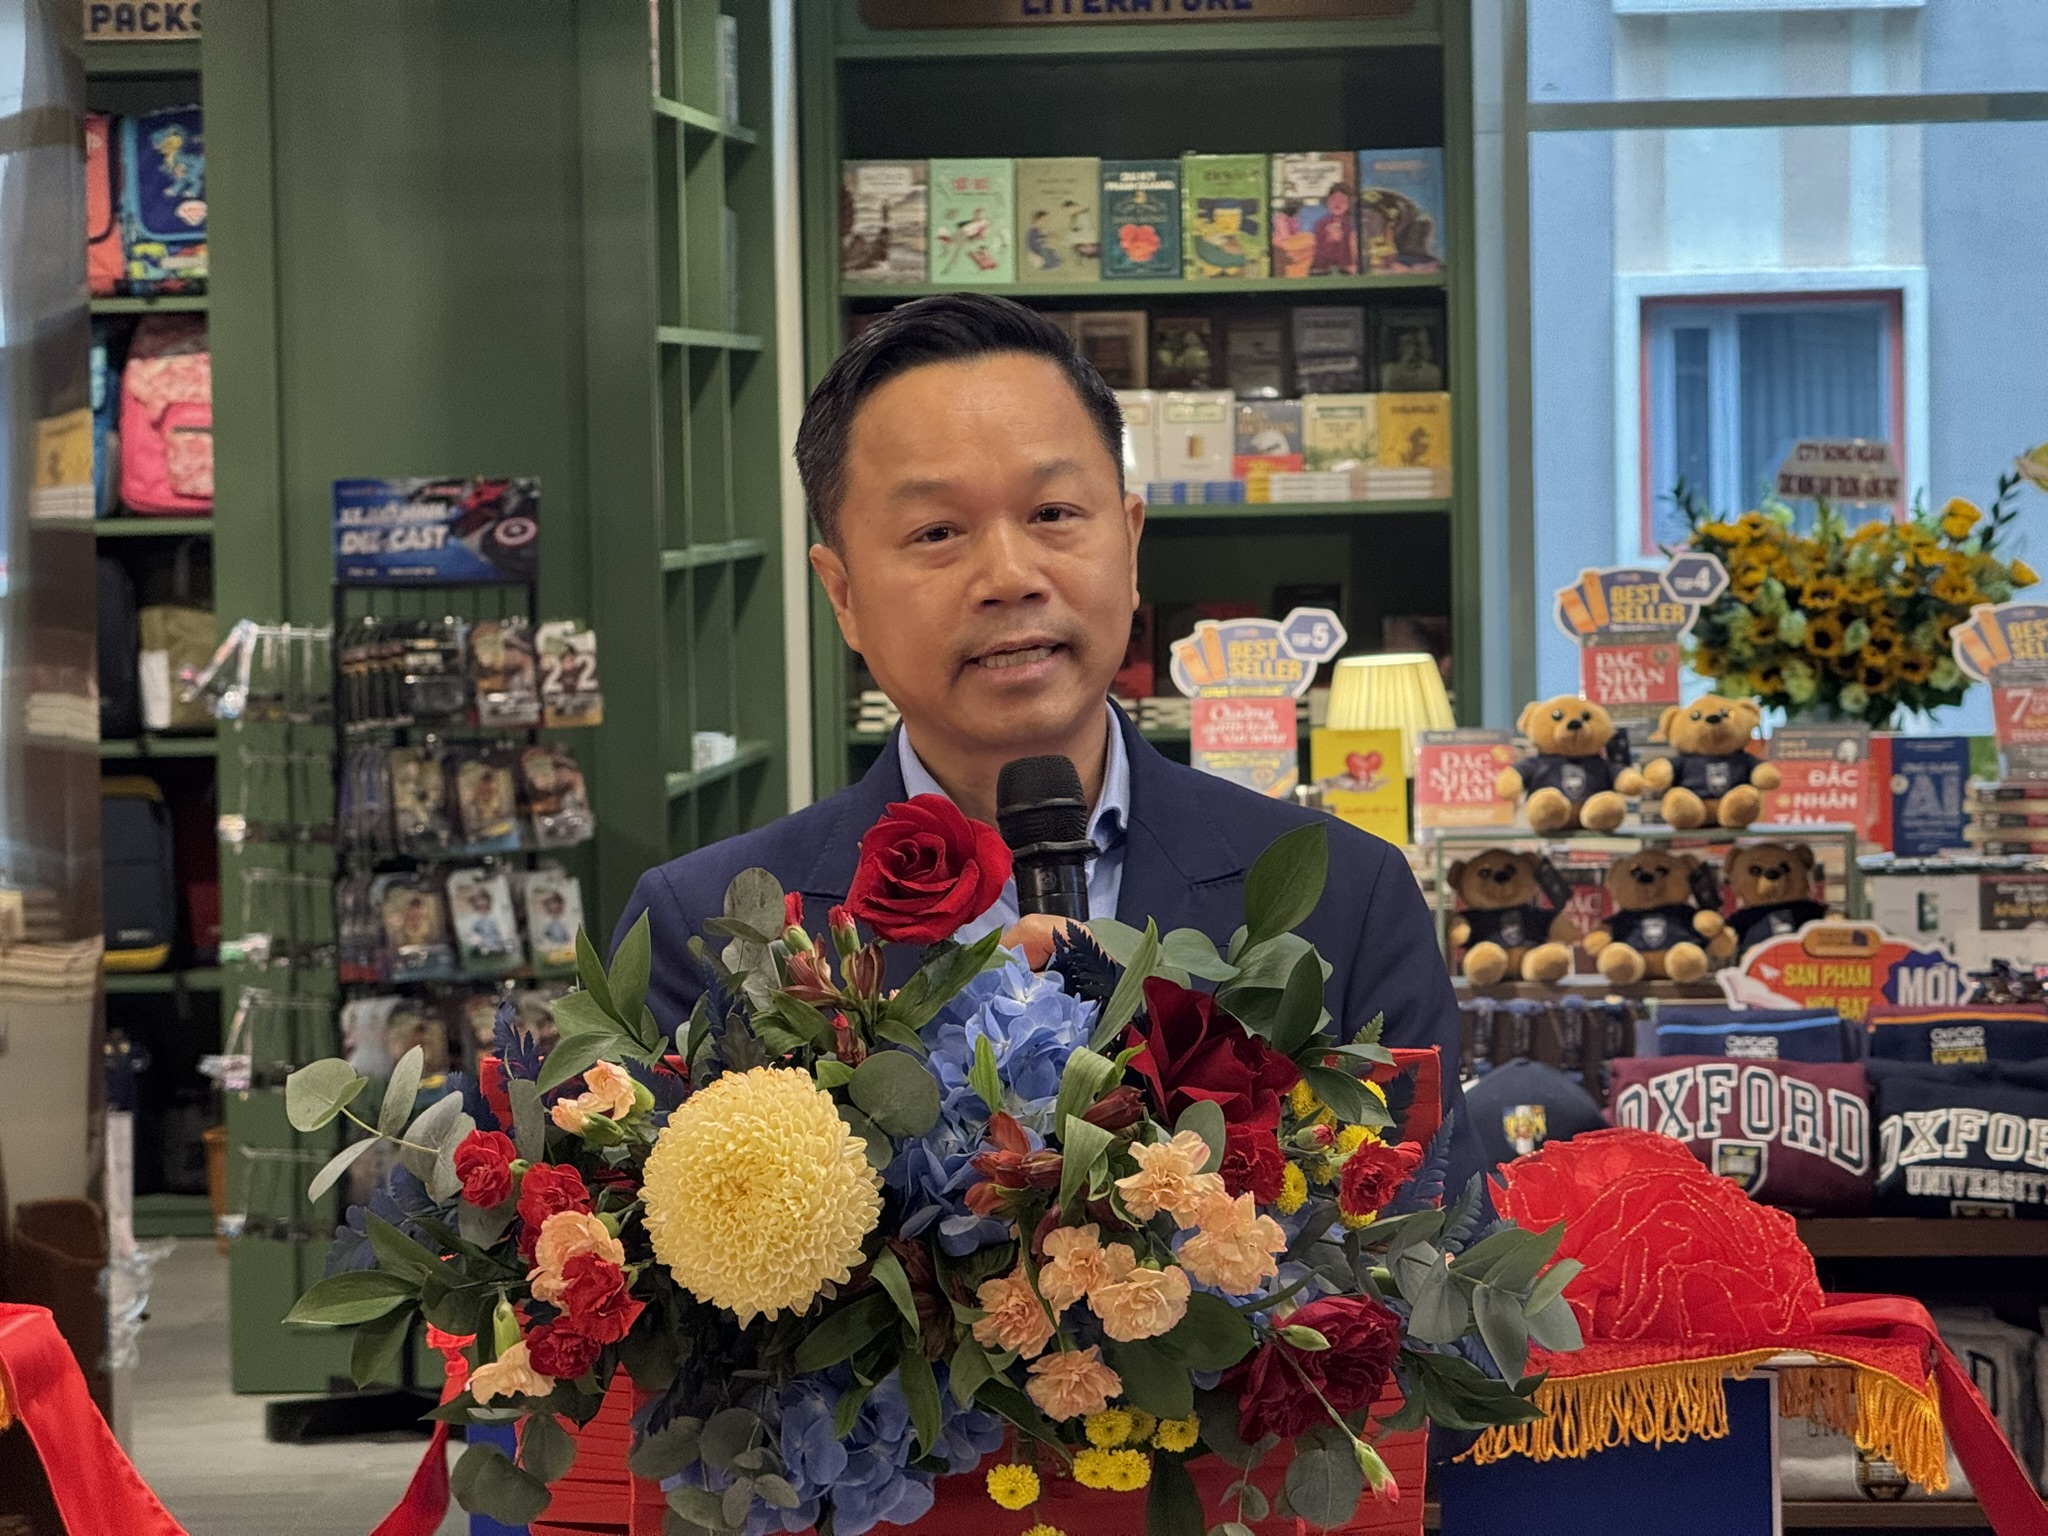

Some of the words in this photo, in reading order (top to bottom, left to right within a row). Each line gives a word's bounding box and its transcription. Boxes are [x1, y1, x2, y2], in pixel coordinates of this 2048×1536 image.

[1610, 583, 1661, 604] BEST
[1611, 603, 1686, 625] SELLER
[1311, 622, 1330, 648] 5
[1228, 638, 1279, 661] BEST
[1228, 658, 1303, 682] SELLER
[1616, 1063, 1870, 1177] OXFORD
